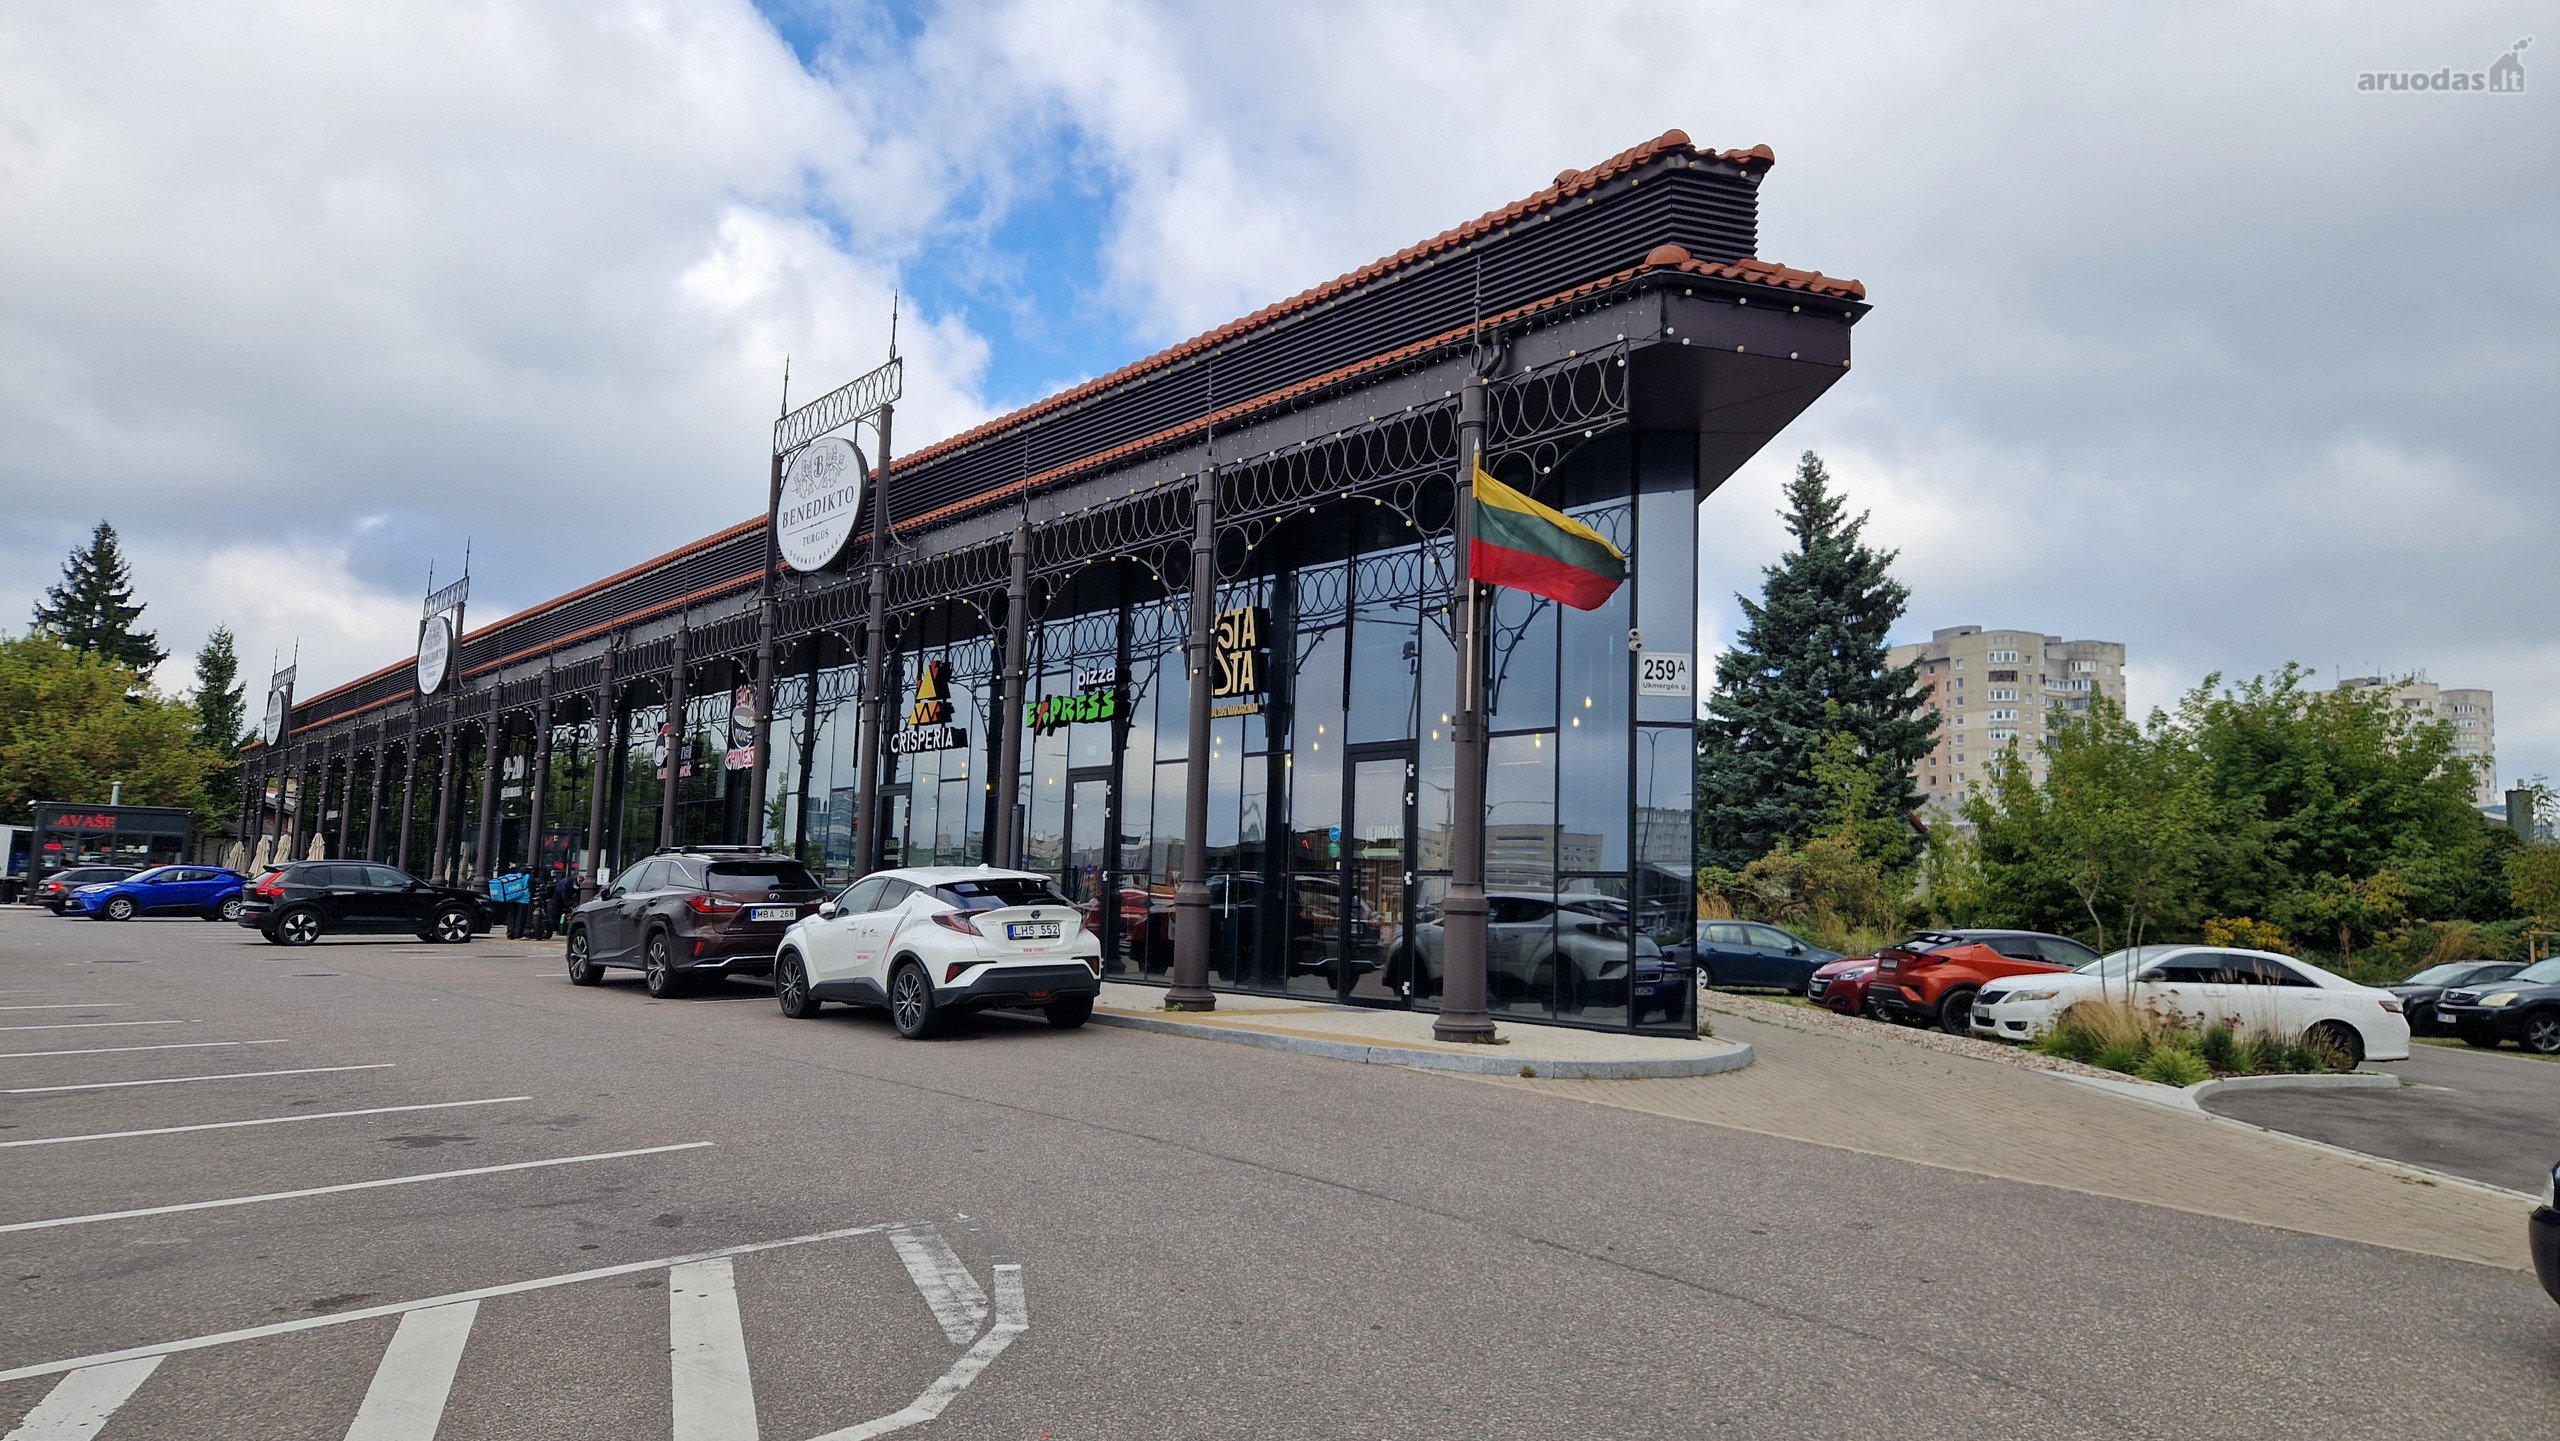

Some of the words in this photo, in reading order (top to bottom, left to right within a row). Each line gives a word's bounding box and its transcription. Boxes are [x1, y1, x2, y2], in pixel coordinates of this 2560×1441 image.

[781, 485, 855, 528] BENEDIKTO
[802, 528, 829, 546] TURGUS
[1077, 667, 1116, 690] pizza
[1642, 682, 1679, 690] Ukmergės
[1026, 689, 1115, 730] EXPRESS
[891, 727, 953, 753] CRISPERIA
[725, 746, 755, 770] CHINES
[757, 910, 775, 918] MBA
[1013, 925, 1035, 936] LHS
[1040, 925, 1058, 935] 552
